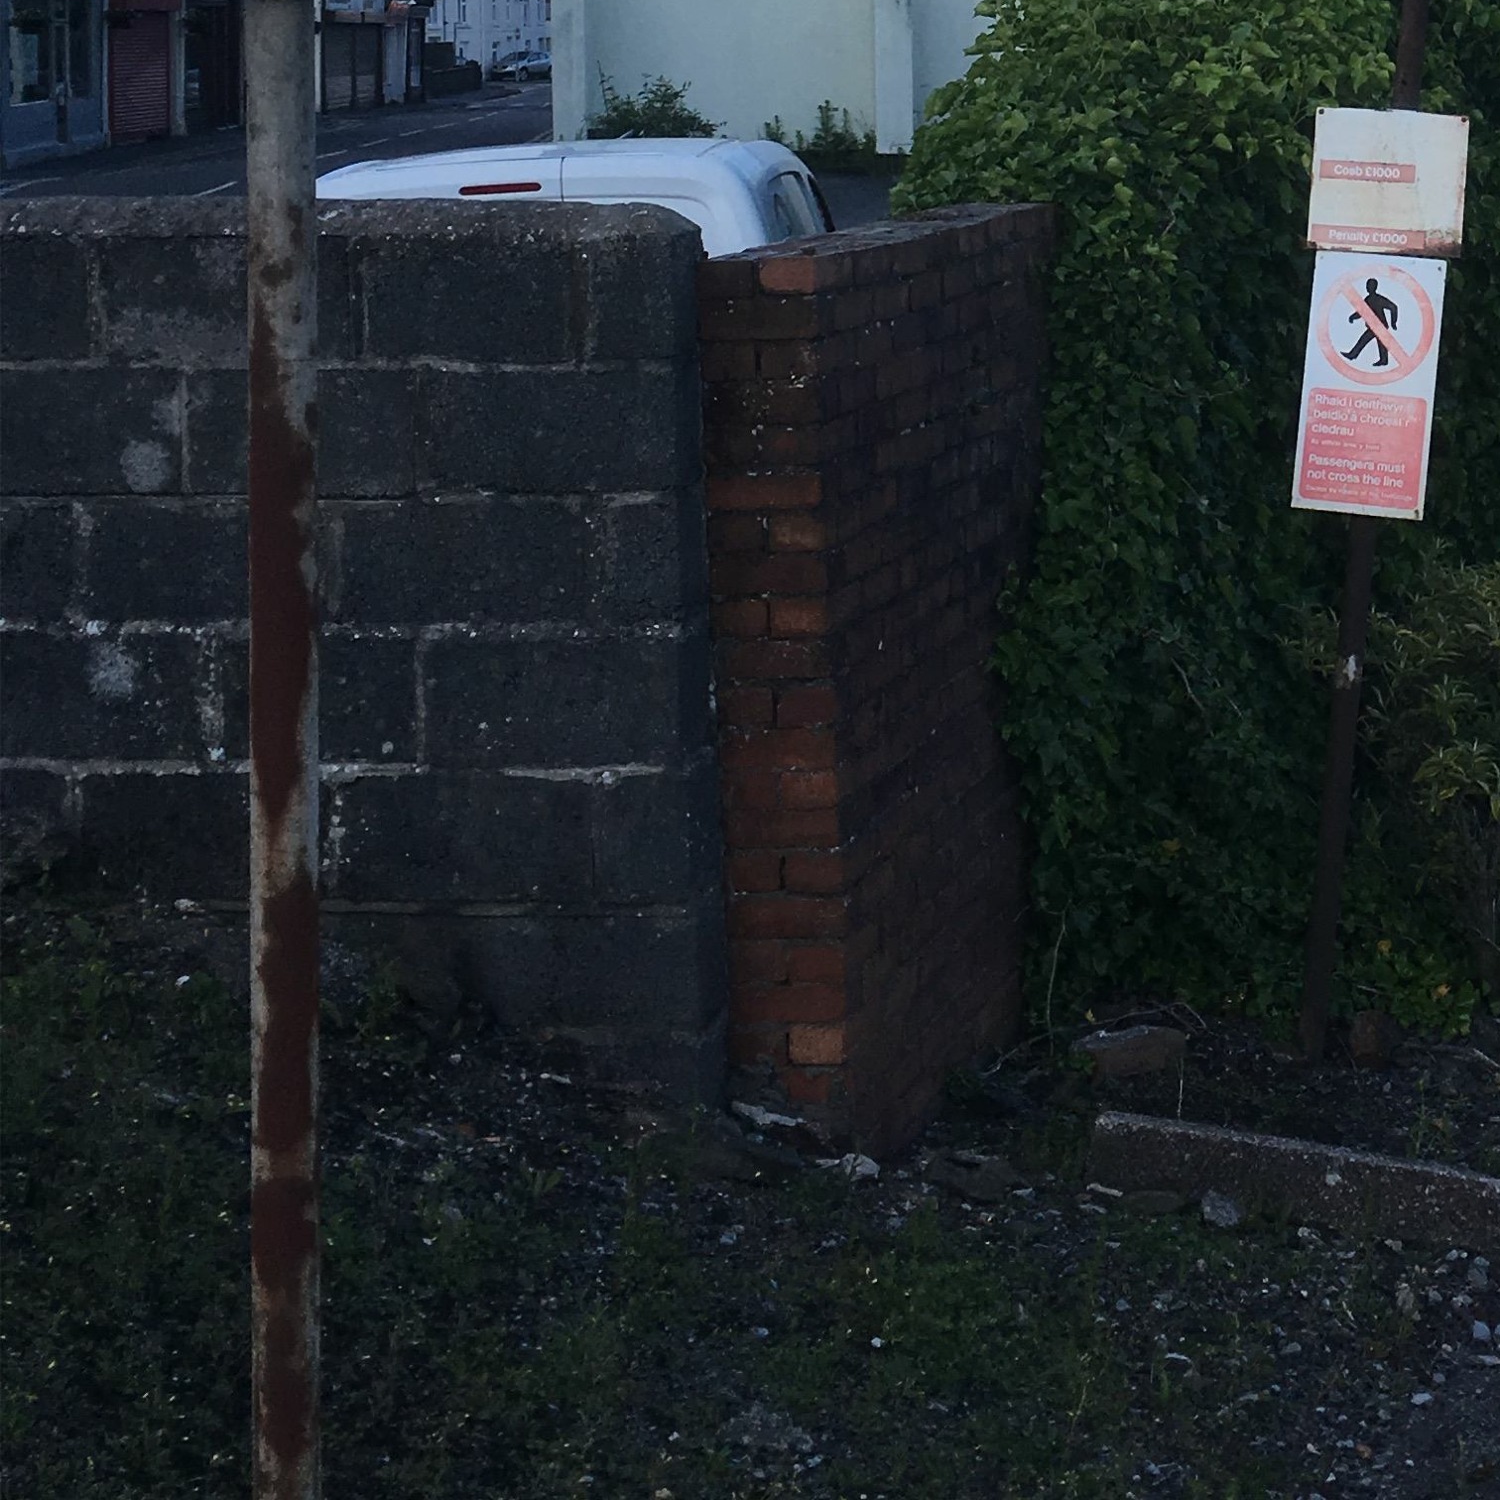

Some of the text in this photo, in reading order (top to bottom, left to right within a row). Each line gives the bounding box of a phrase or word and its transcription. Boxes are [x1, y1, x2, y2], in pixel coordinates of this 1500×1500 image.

[1365, 166, 1400, 178] £1000
[1329, 229, 1407, 244] Penalty £1000
[1315, 394, 1347, 406] Rhaid
[1311, 423, 1354, 436] cledrau
[1308, 453, 1405, 474] Passengers must
[1306, 469, 1404, 488] not cross the line
